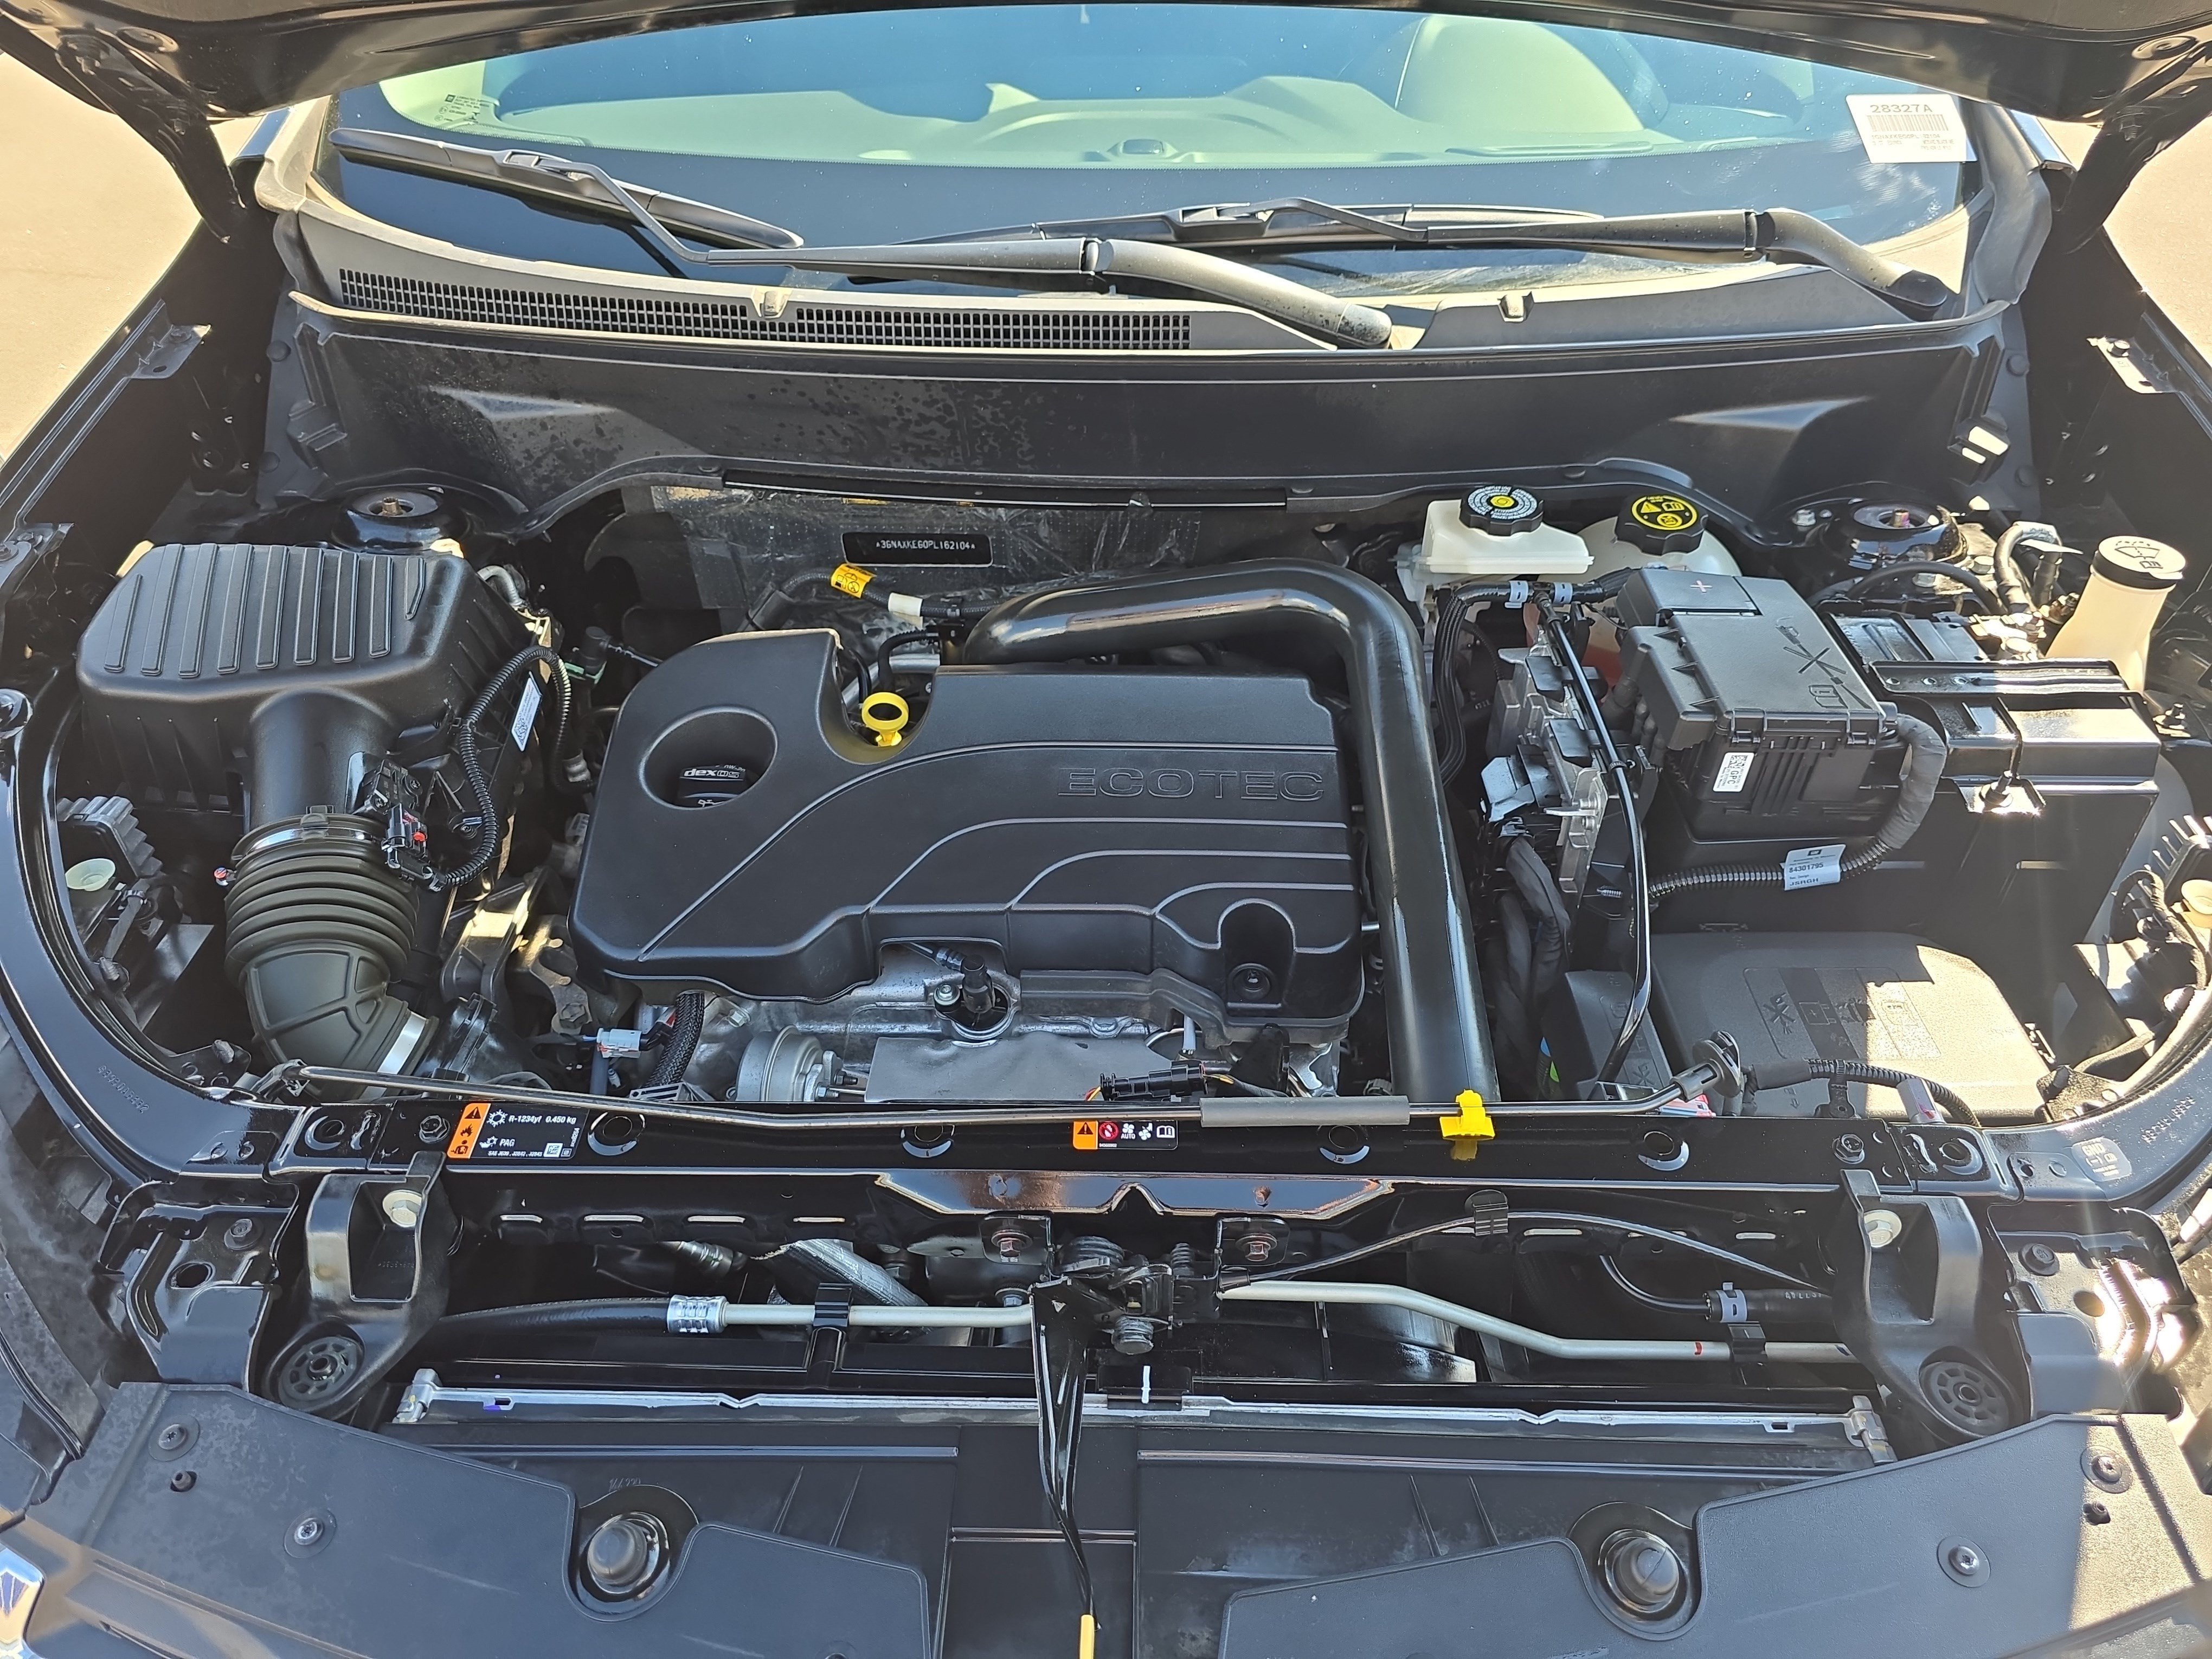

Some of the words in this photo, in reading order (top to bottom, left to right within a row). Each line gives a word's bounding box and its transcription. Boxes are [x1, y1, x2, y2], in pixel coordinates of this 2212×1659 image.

[1870, 104, 1933, 113] 28327A
[684, 768, 741, 778] dexos
[1727, 770, 1739, 784] GPC
[1058, 767, 1324, 801] ECOTEC
[1789, 863, 1824, 873] 84301795
[509, 1115, 542, 1123] R-1234yf
[567, 1116, 576, 1125] kg
[499, 1139, 516, 1147] PAG
[2082, 1142, 2106, 1156] GND
